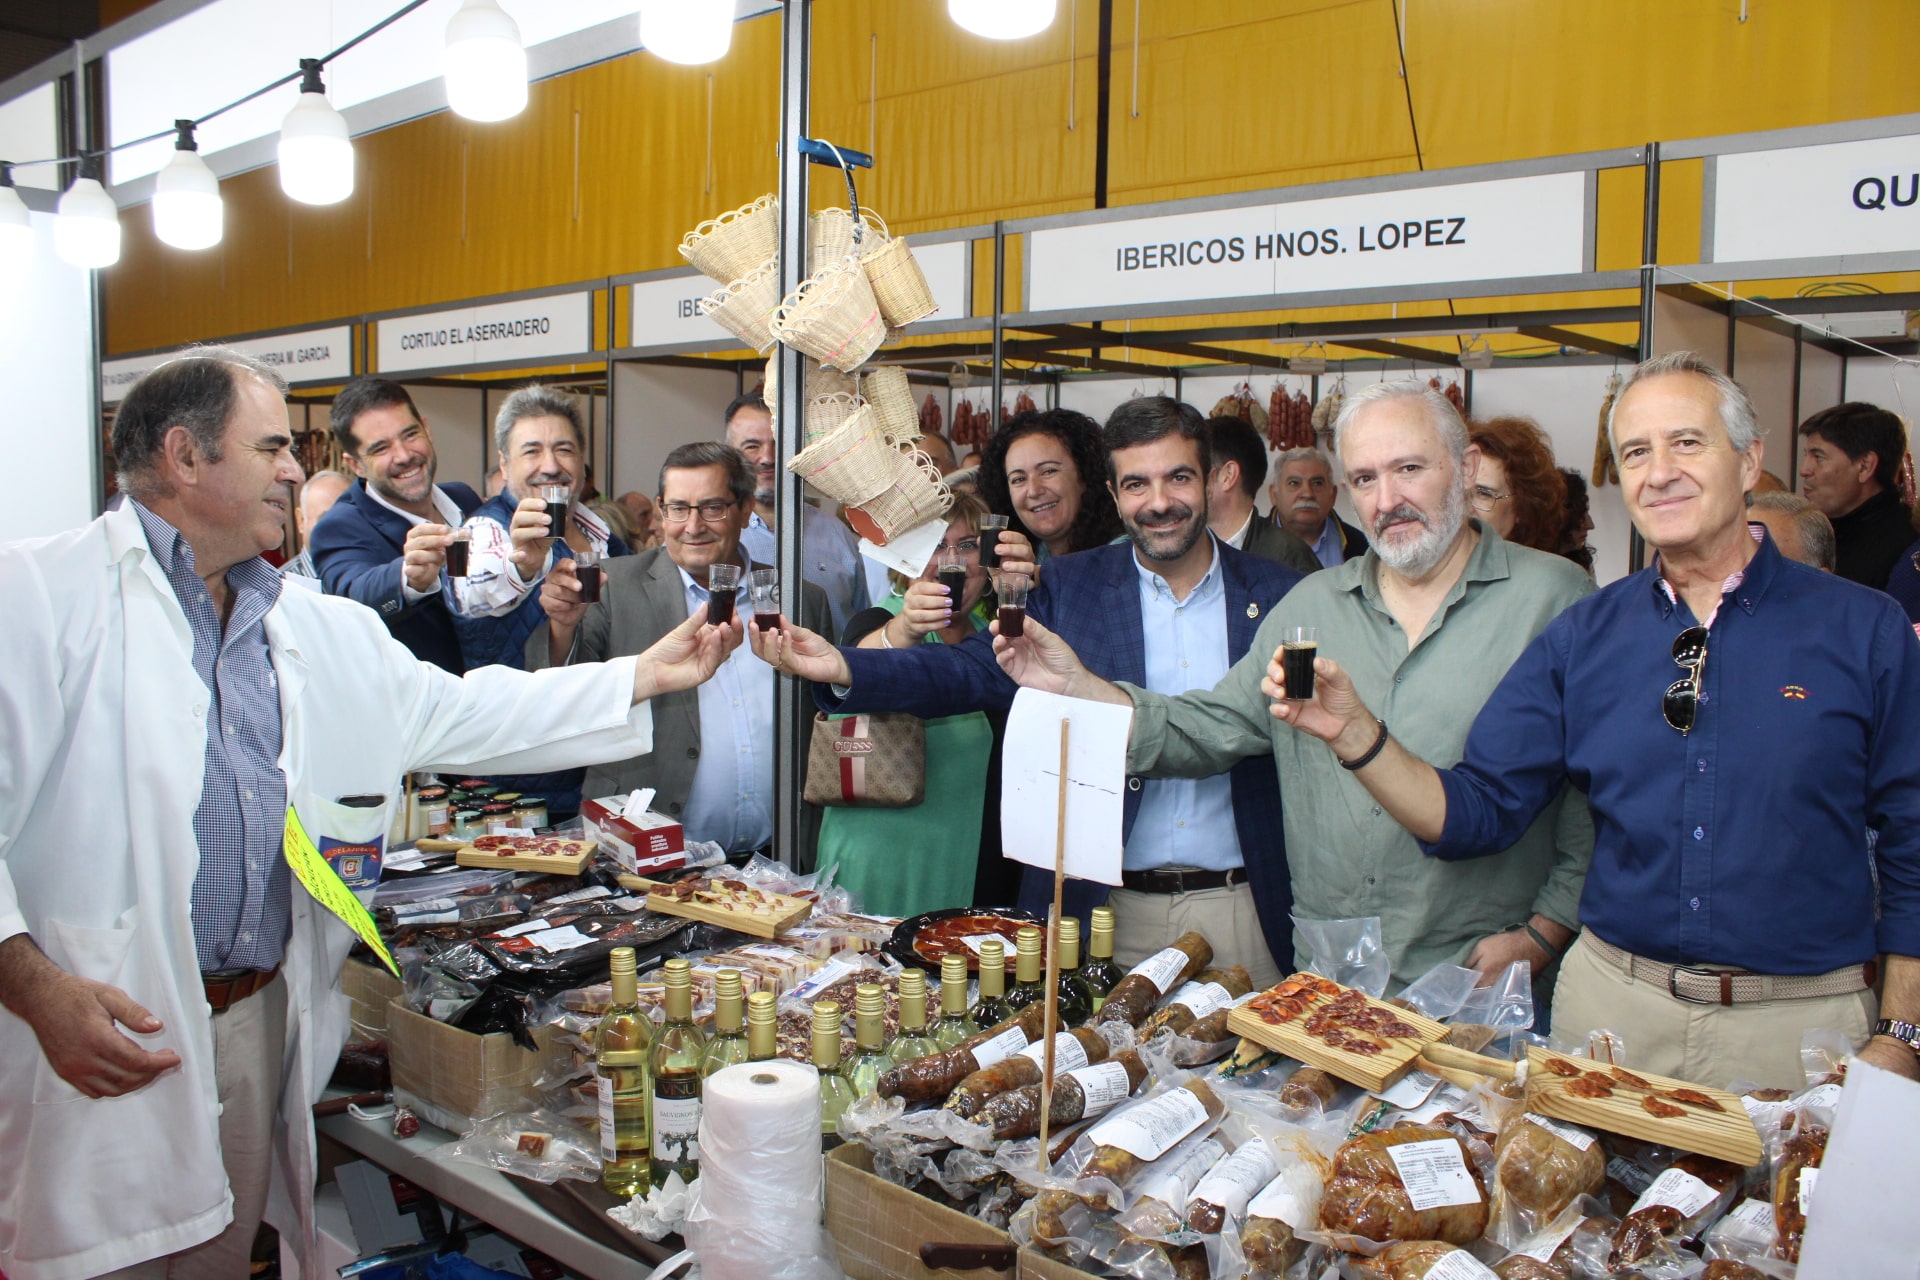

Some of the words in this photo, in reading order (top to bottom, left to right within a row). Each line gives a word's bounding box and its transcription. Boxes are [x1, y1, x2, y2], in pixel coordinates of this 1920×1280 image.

[1116, 237, 1245, 271] IBERICOS
[1255, 229, 1347, 260] HNOS.
[1359, 217, 1466, 252] LOPEZ
[401, 330, 447, 350] CORTIJO
[450, 329, 464, 344] EL
[466, 317, 550, 342] ASERRADERO
[297, 345, 331, 363] GARCIA
[833, 741, 873, 752] GUESS
